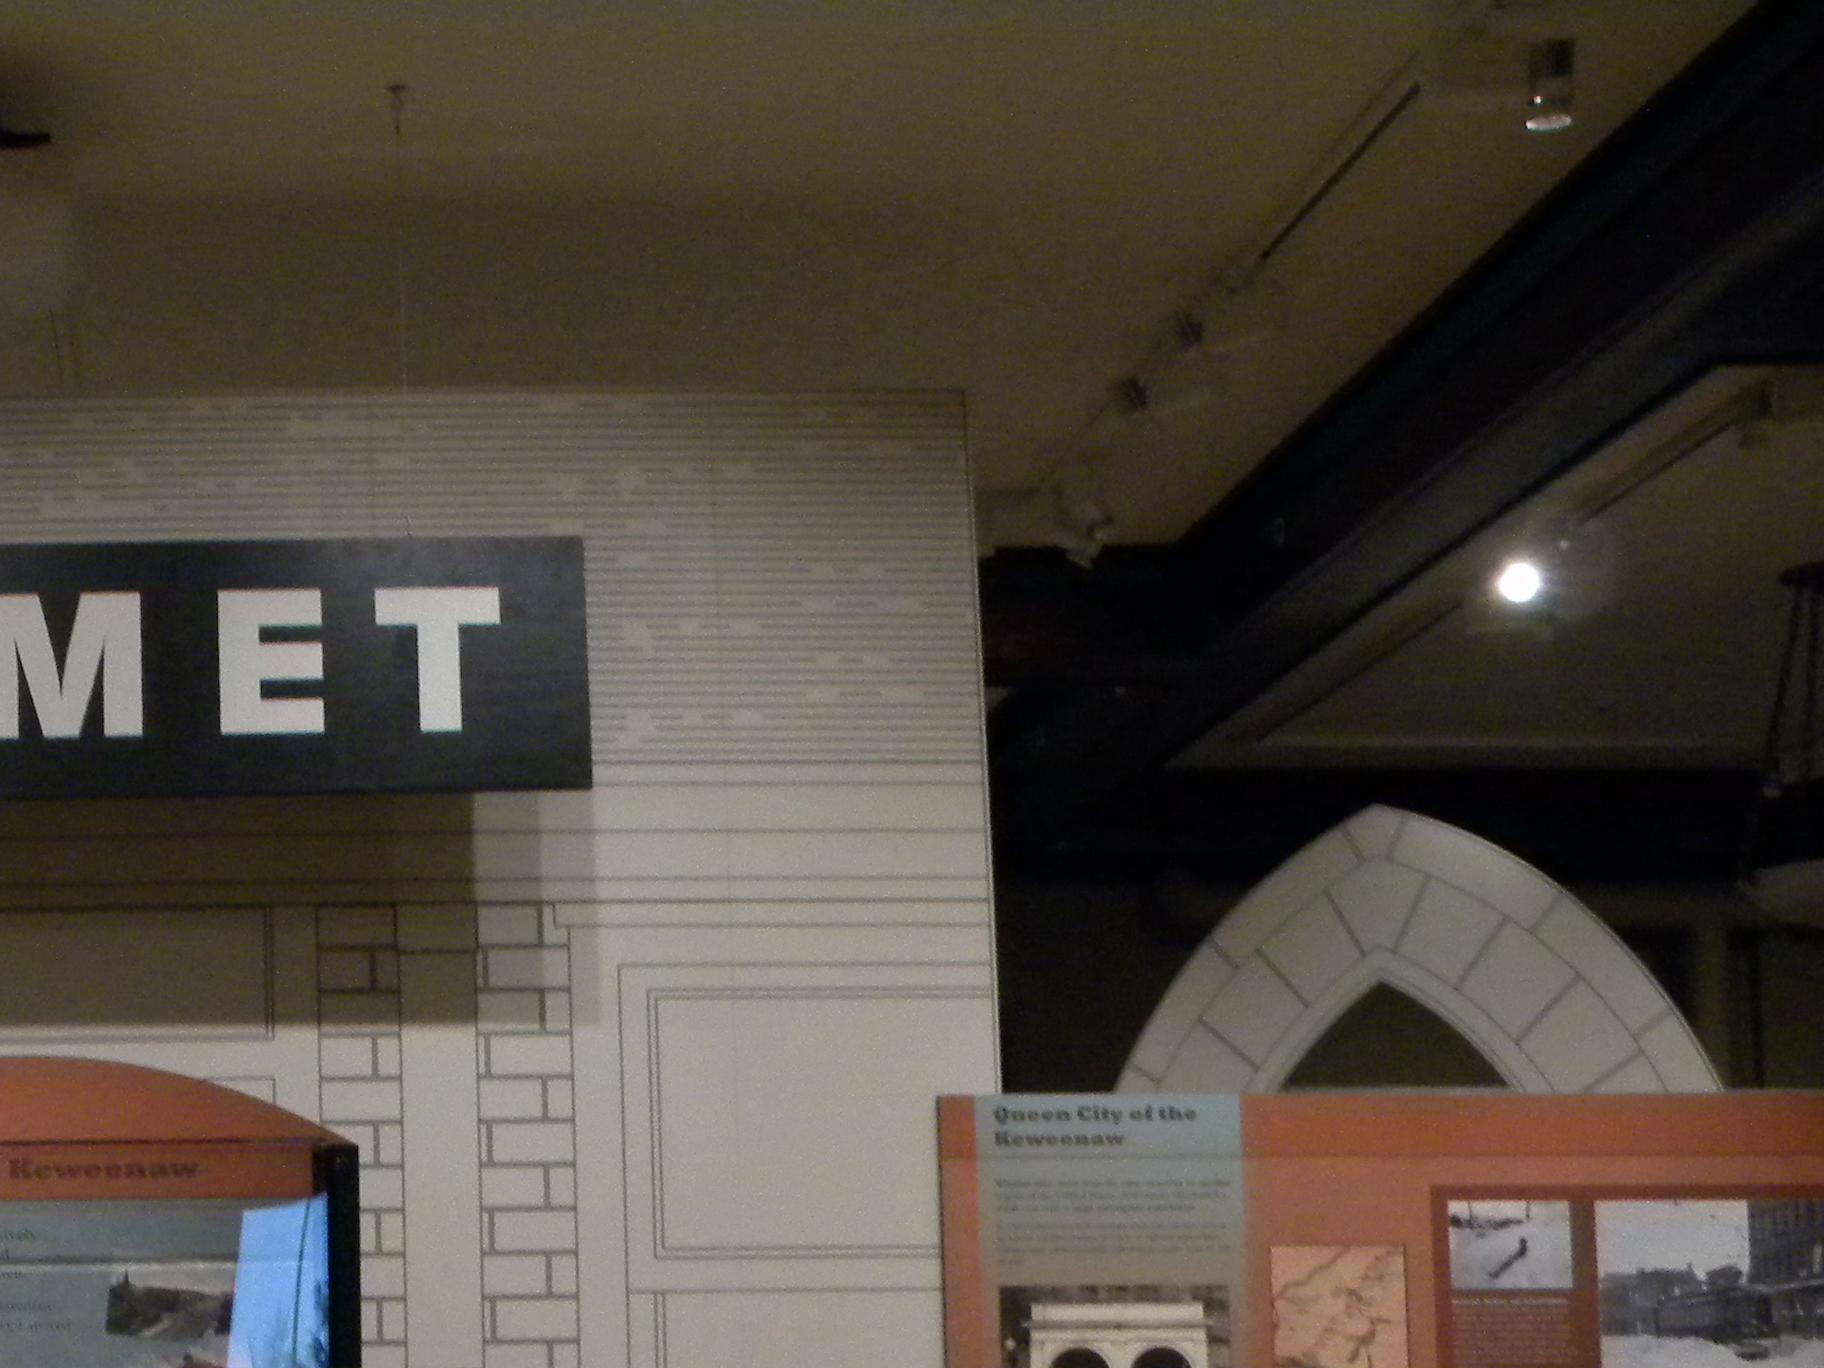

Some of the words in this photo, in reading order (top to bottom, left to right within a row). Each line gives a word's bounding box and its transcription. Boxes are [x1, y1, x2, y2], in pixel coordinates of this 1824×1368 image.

[993, 1105, 1071, 1125] Queen
[1076, 1105, 1123, 1125] City
[1129, 1104, 1153, 1121] of
[1158, 1105, 1197, 1121] the
[994, 1131, 1125, 1147] Keweenaw
[8, 1158, 199, 1180] Keweenaw
